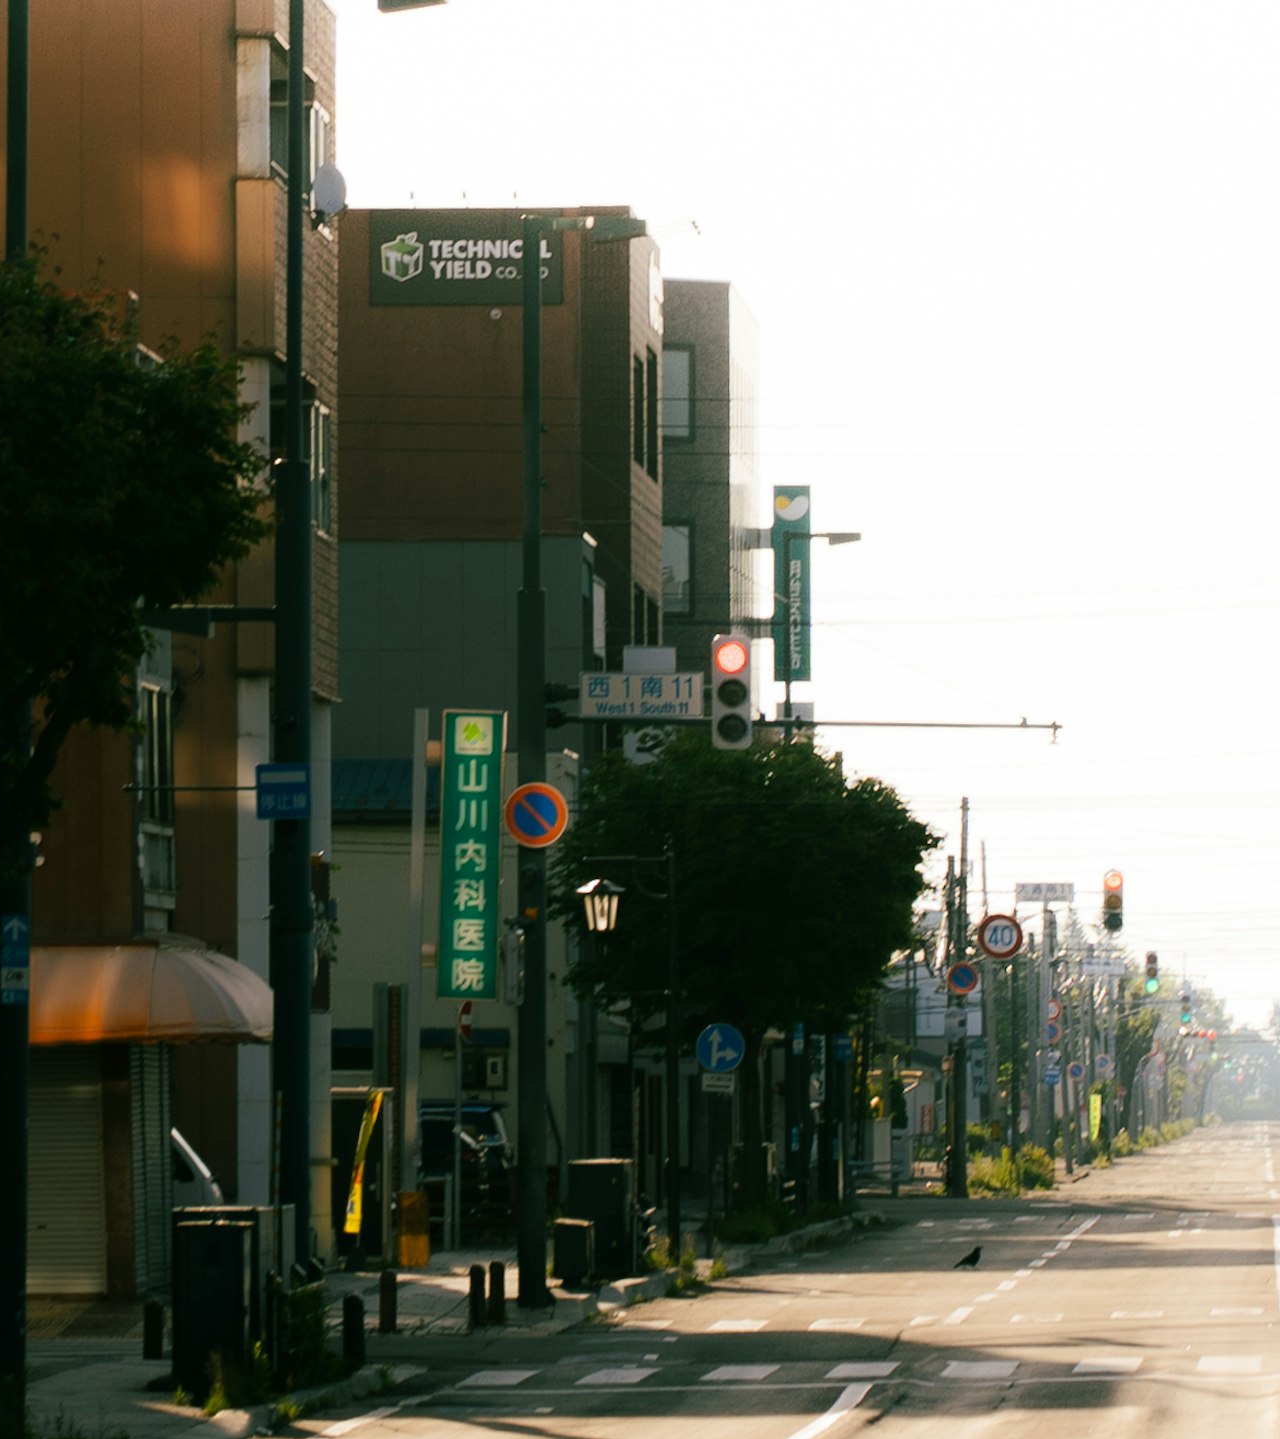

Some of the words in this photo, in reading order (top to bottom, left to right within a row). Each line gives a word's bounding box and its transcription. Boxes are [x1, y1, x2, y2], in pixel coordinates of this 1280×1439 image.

[428, 239, 552, 259] TECHNICL
[429, 261, 493, 280] YIELD
[450, 759, 489, 992] 山川内科医院
[988, 925, 1014, 947] 40
